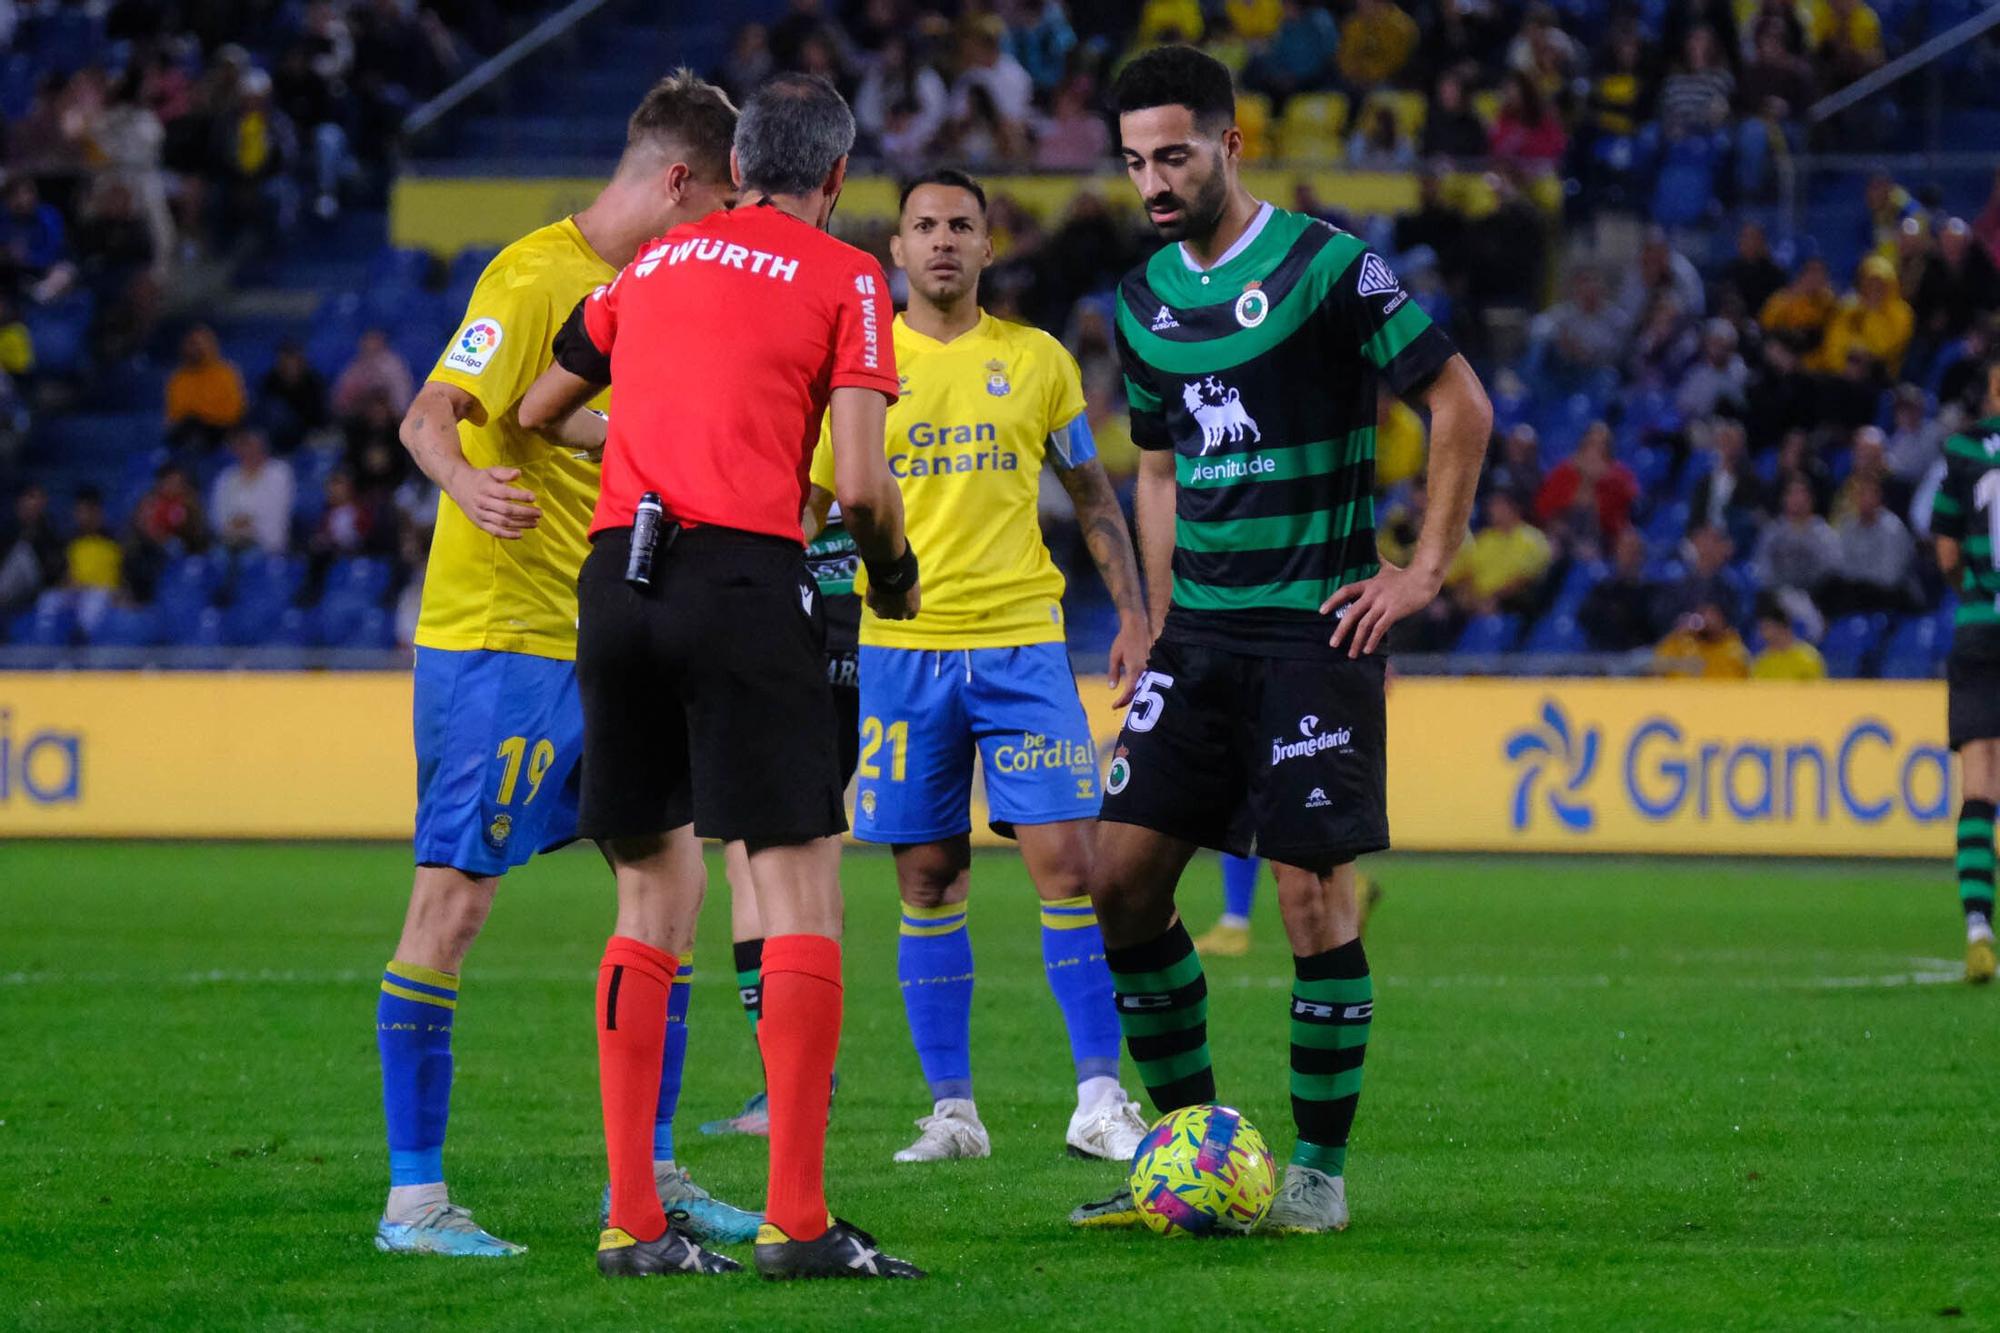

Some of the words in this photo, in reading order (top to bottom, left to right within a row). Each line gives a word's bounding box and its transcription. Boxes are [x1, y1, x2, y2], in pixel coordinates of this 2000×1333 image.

[668, 237, 800, 282] WÜRTH
[864, 299, 878, 369] WÜRTH
[450, 352, 482, 368] LaLiga
[908, 421, 996, 449] Gran
[888, 444, 1018, 480] Canaria
[859, 716, 909, 782] 21
[994, 739, 1094, 774] Cordial
[1023, 732, 1046, 749] be
[1272, 727, 1351, 766] Dromedario
[496, 736, 556, 806] 19
